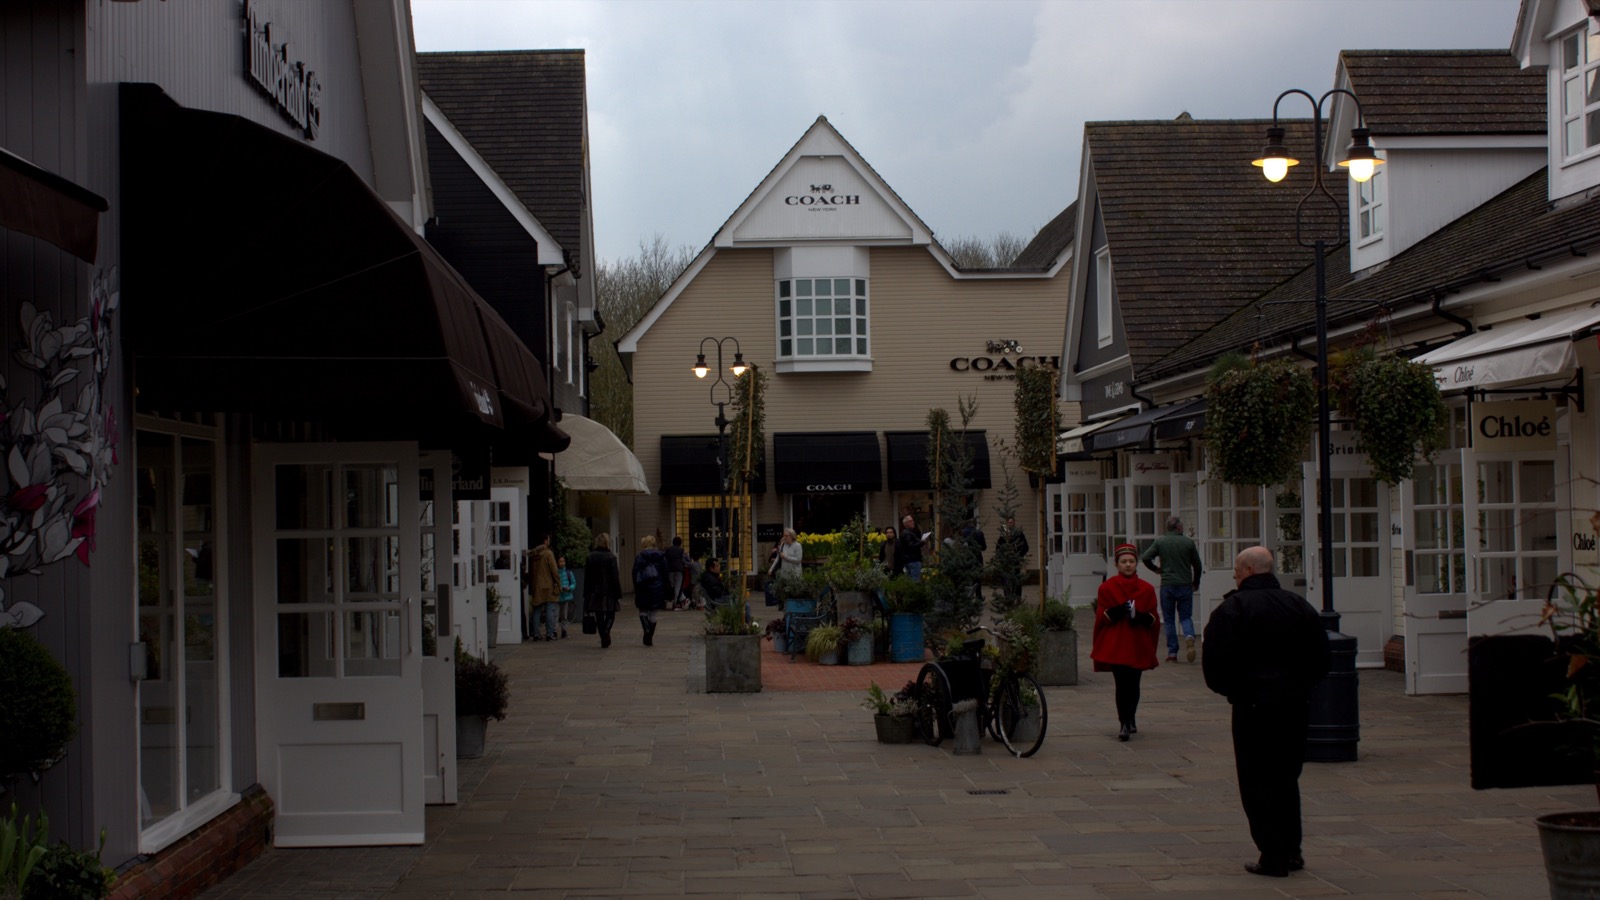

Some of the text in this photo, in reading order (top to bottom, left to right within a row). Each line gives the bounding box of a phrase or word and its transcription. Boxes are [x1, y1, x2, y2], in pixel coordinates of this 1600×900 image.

[785, 195, 860, 205] COACH
[950, 356, 1060, 372] COACH
[1454, 365, 1474, 384] Chloé
[1480, 415, 1550, 438] Chloé
[420, 475, 483, 490] Tirland
[1573, 532, 1595, 550] Chloé
